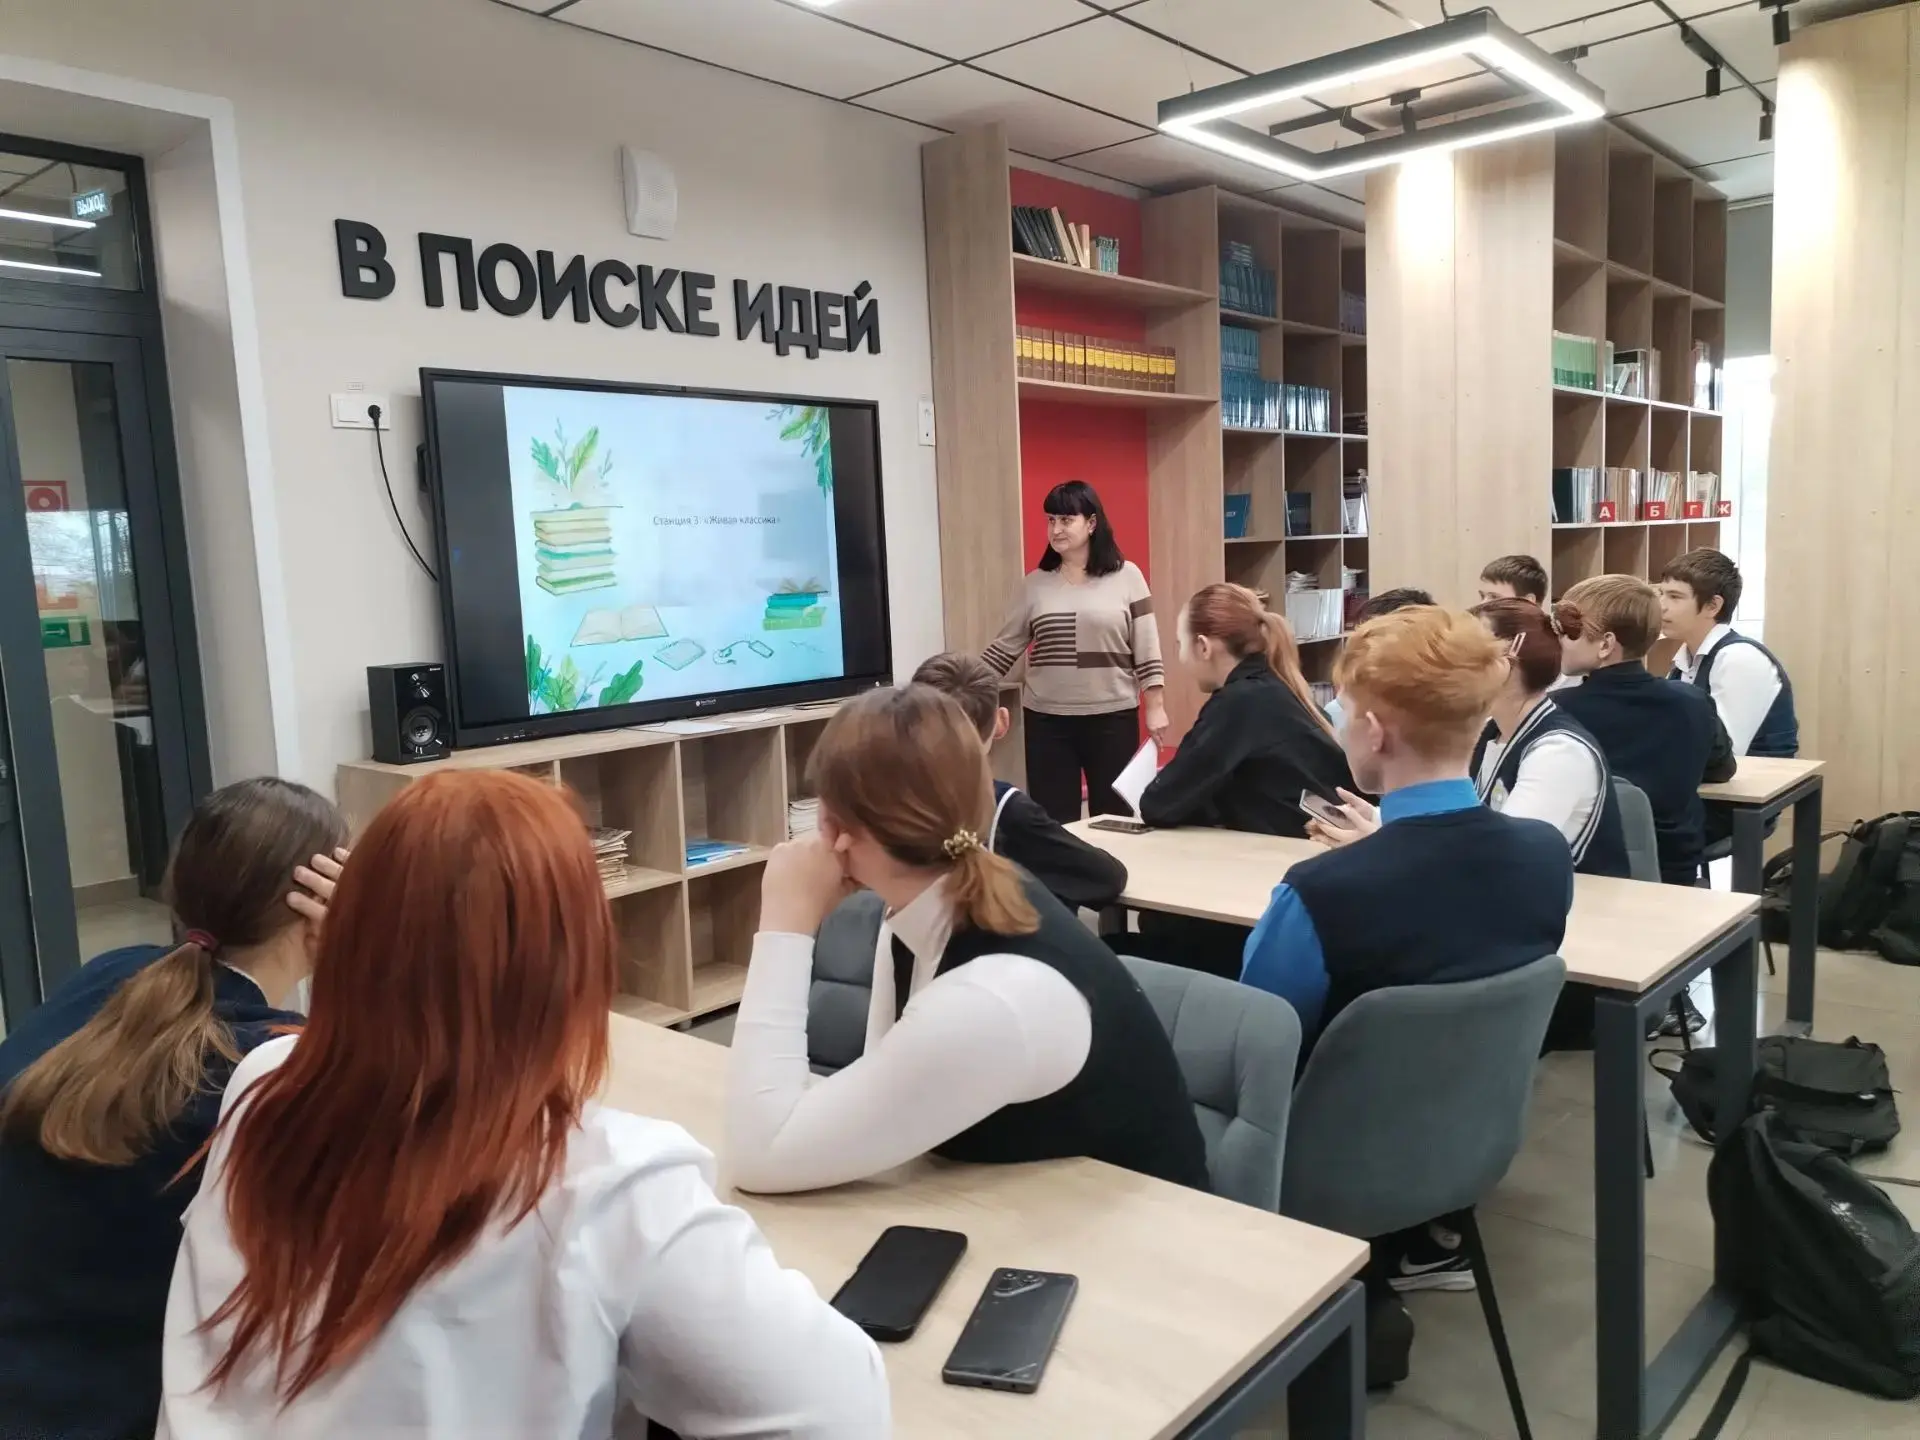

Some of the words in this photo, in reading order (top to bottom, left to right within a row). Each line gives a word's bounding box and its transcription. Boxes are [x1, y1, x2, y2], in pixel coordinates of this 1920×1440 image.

[76, 193, 107, 215] ВЫХОД
[335, 218, 396, 299] В
[418, 232, 720, 337] ПОИСКЕ
[733, 280, 881, 359] ИДЕЙ
[1599, 505, 1612, 518] А
[1649, 505, 1660, 517] Б
[1689, 505, 1697, 516] Г
[653, 515, 691, 526] Станция
